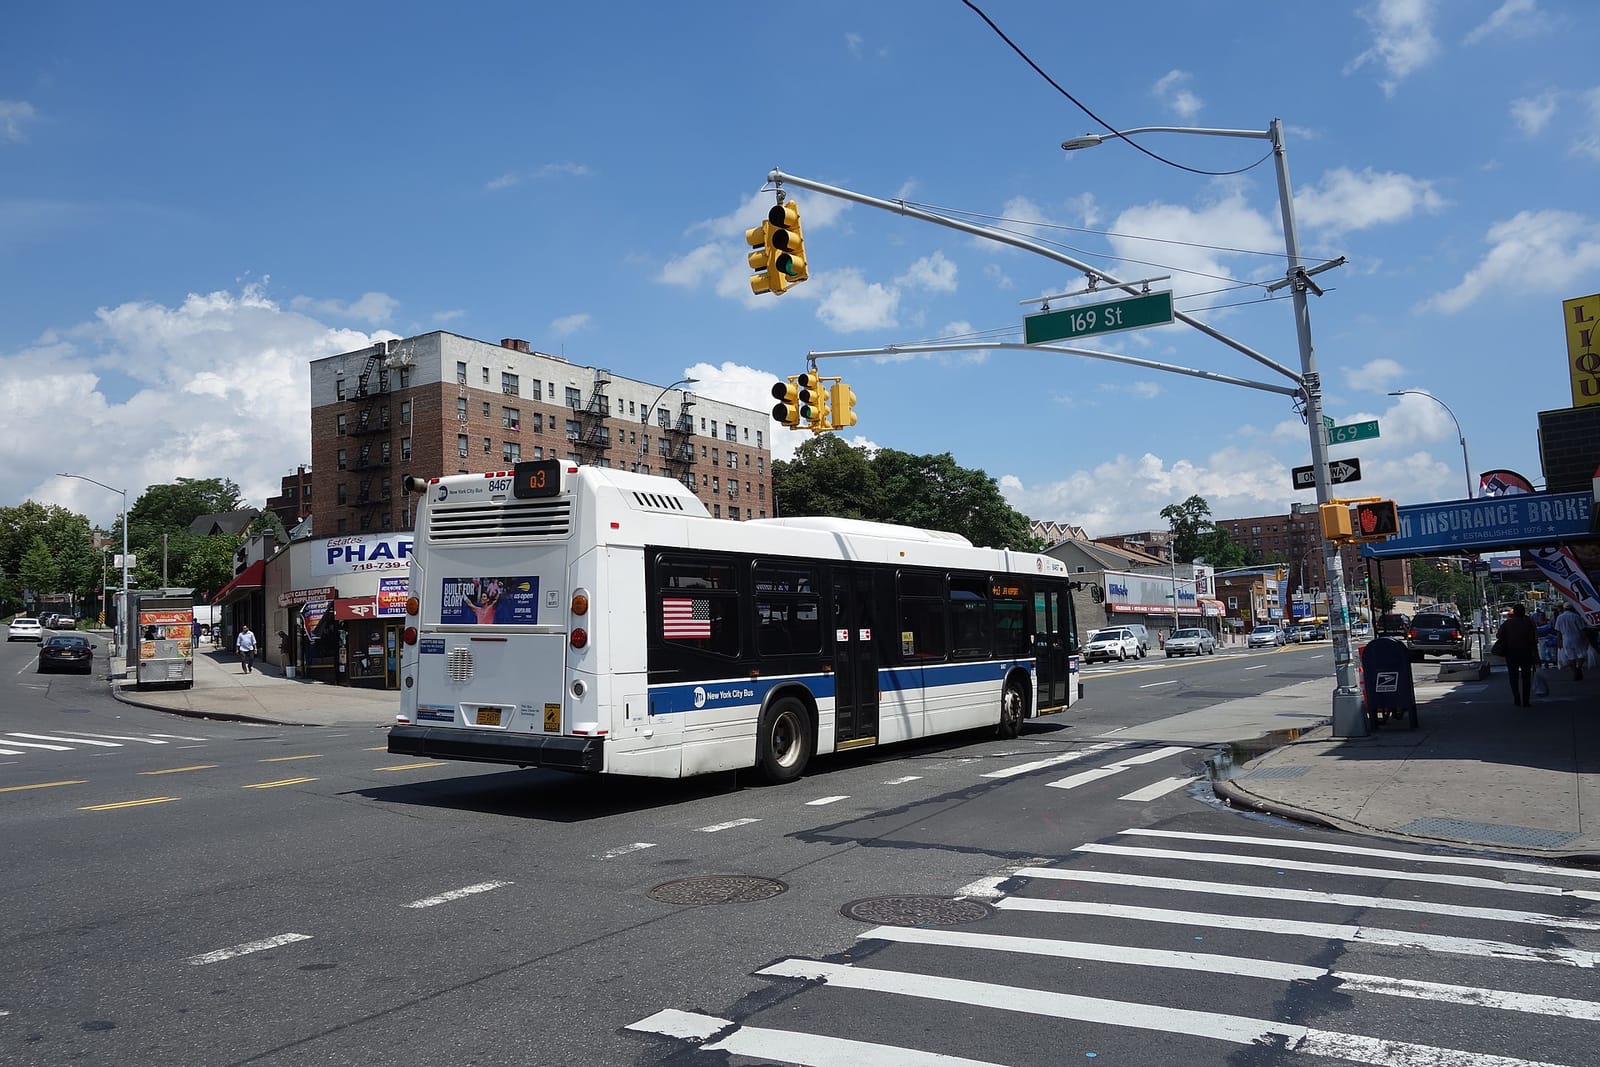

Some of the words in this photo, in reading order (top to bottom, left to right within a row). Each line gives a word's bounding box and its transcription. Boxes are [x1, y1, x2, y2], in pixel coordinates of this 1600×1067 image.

[1070, 311, 1096, 332] 169
[1104, 307, 1123, 326] St
[1572, 305, 1600, 406] LIQU
[1329, 426, 1357, 442] 169
[1367, 422, 1377, 431] ST
[488, 479, 512, 492] 8467
[1527, 496, 1592, 523] BROKE
[1463, 527, 1519, 540] ESTABLISHED
[1523, 525, 1542, 534] 1975
[326, 535, 363, 548] Estates
[463, 582, 475, 595] FOR
[707, 692, 719, 700] New
[720, 690, 732, 699] York
[732, 689, 743, 699] City
[743, 688, 754, 697] Bus
